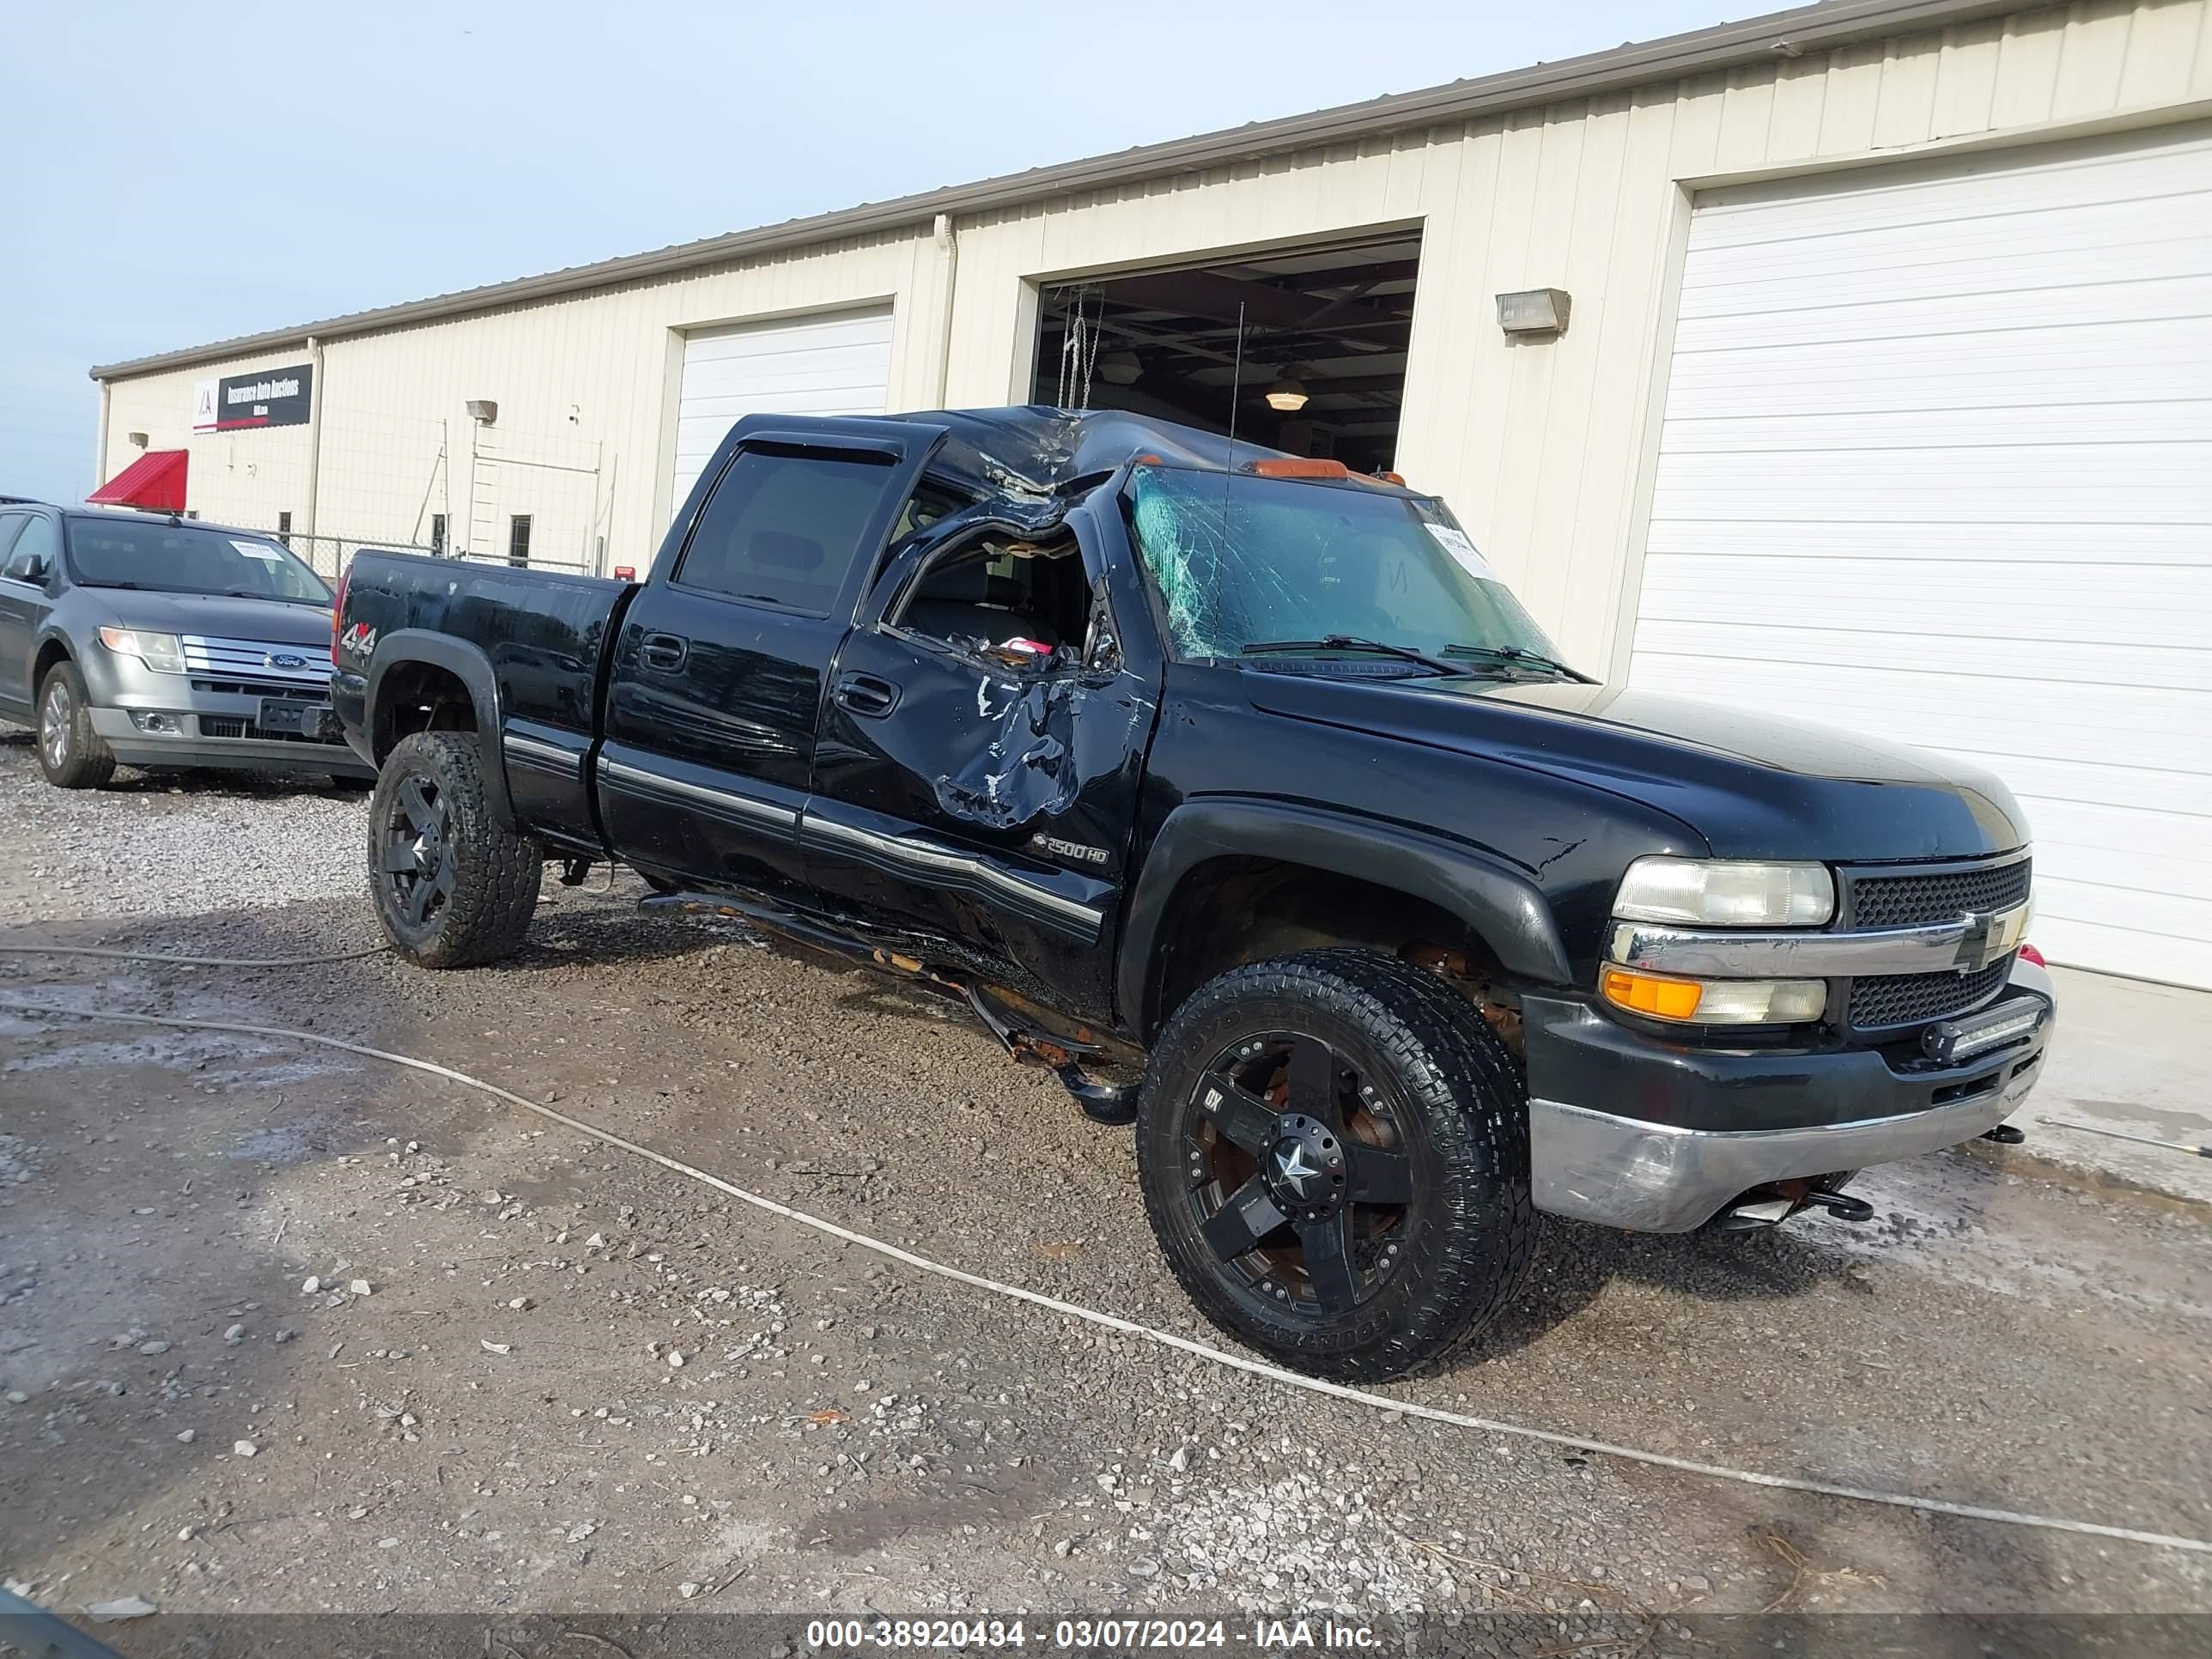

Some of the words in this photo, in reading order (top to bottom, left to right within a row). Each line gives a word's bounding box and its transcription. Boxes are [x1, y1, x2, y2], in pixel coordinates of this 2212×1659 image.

[228, 386, 257, 404] Insurance
[257, 381, 270, 401] Auto
[270, 378, 299, 398] Auctions
[276, 655, 301, 666] Ford
[1048, 837, 1085, 860] 2500
[1087, 848, 1108, 863] HD
